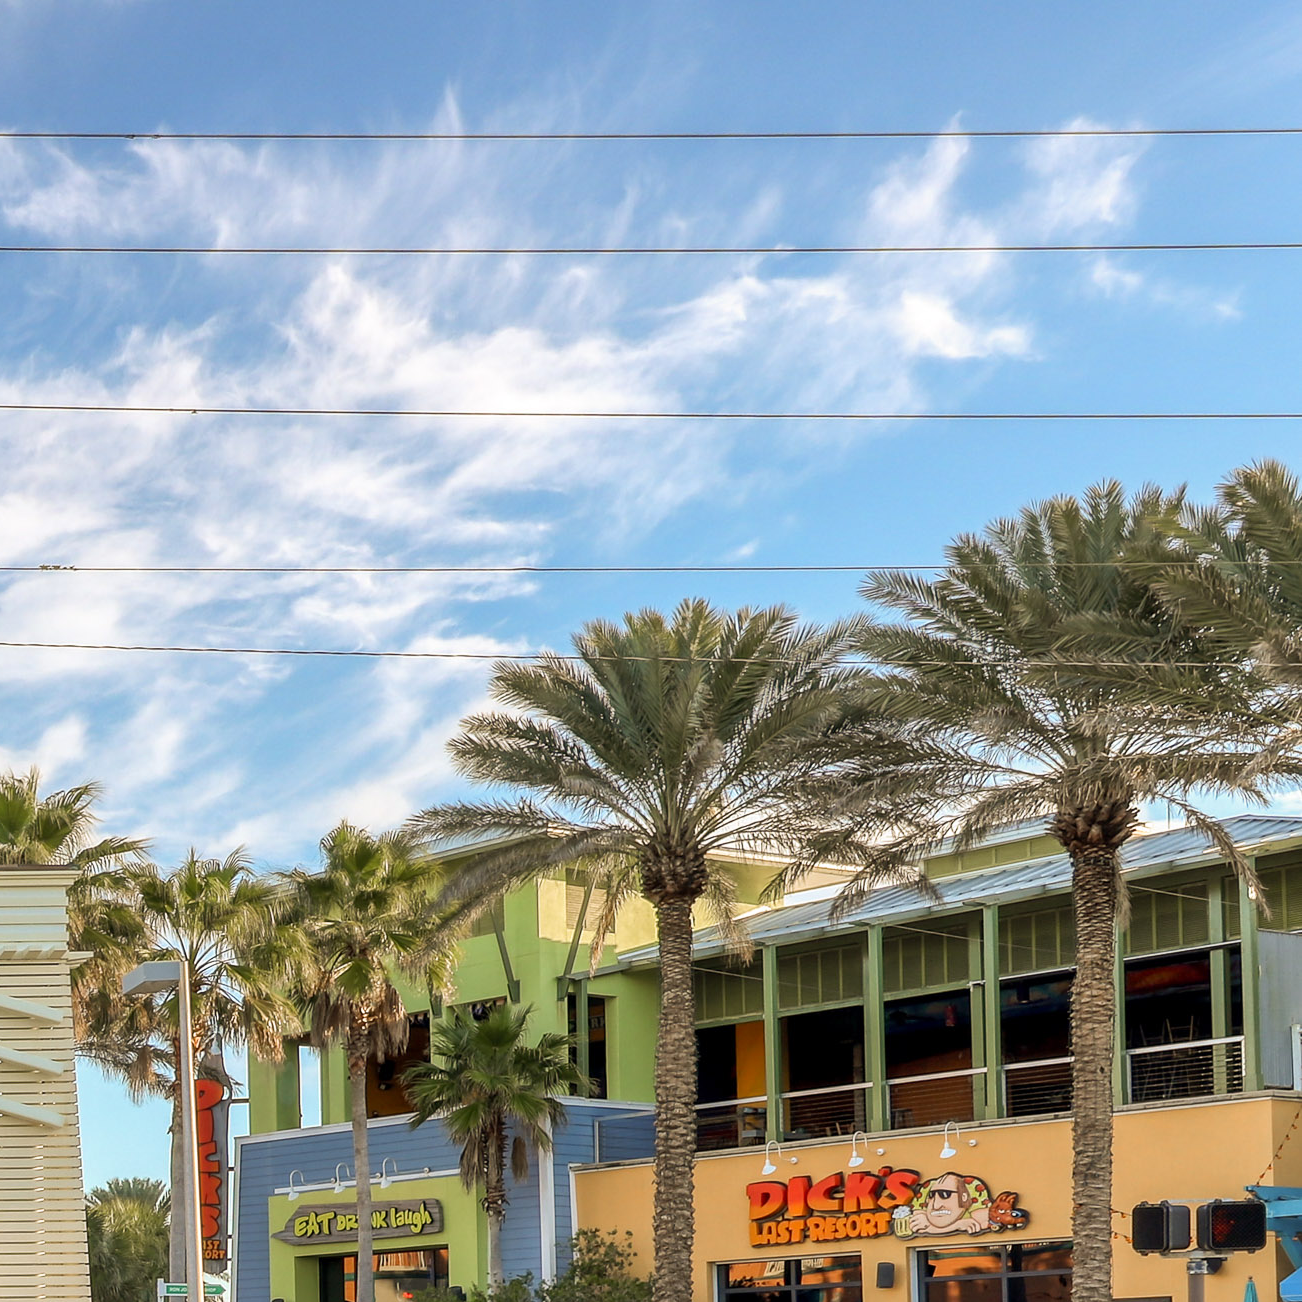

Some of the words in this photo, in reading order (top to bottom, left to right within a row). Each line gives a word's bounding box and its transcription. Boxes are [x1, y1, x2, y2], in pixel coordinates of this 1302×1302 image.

[746, 1166, 922, 1221] DICK'S
[294, 1211, 335, 1237] EAT
[336, 1210, 388, 1231] DRNK
[390, 1201, 432, 1234] laugh
[748, 1217, 805, 1247] LAST
[806, 1212, 893, 1242] RESORT
